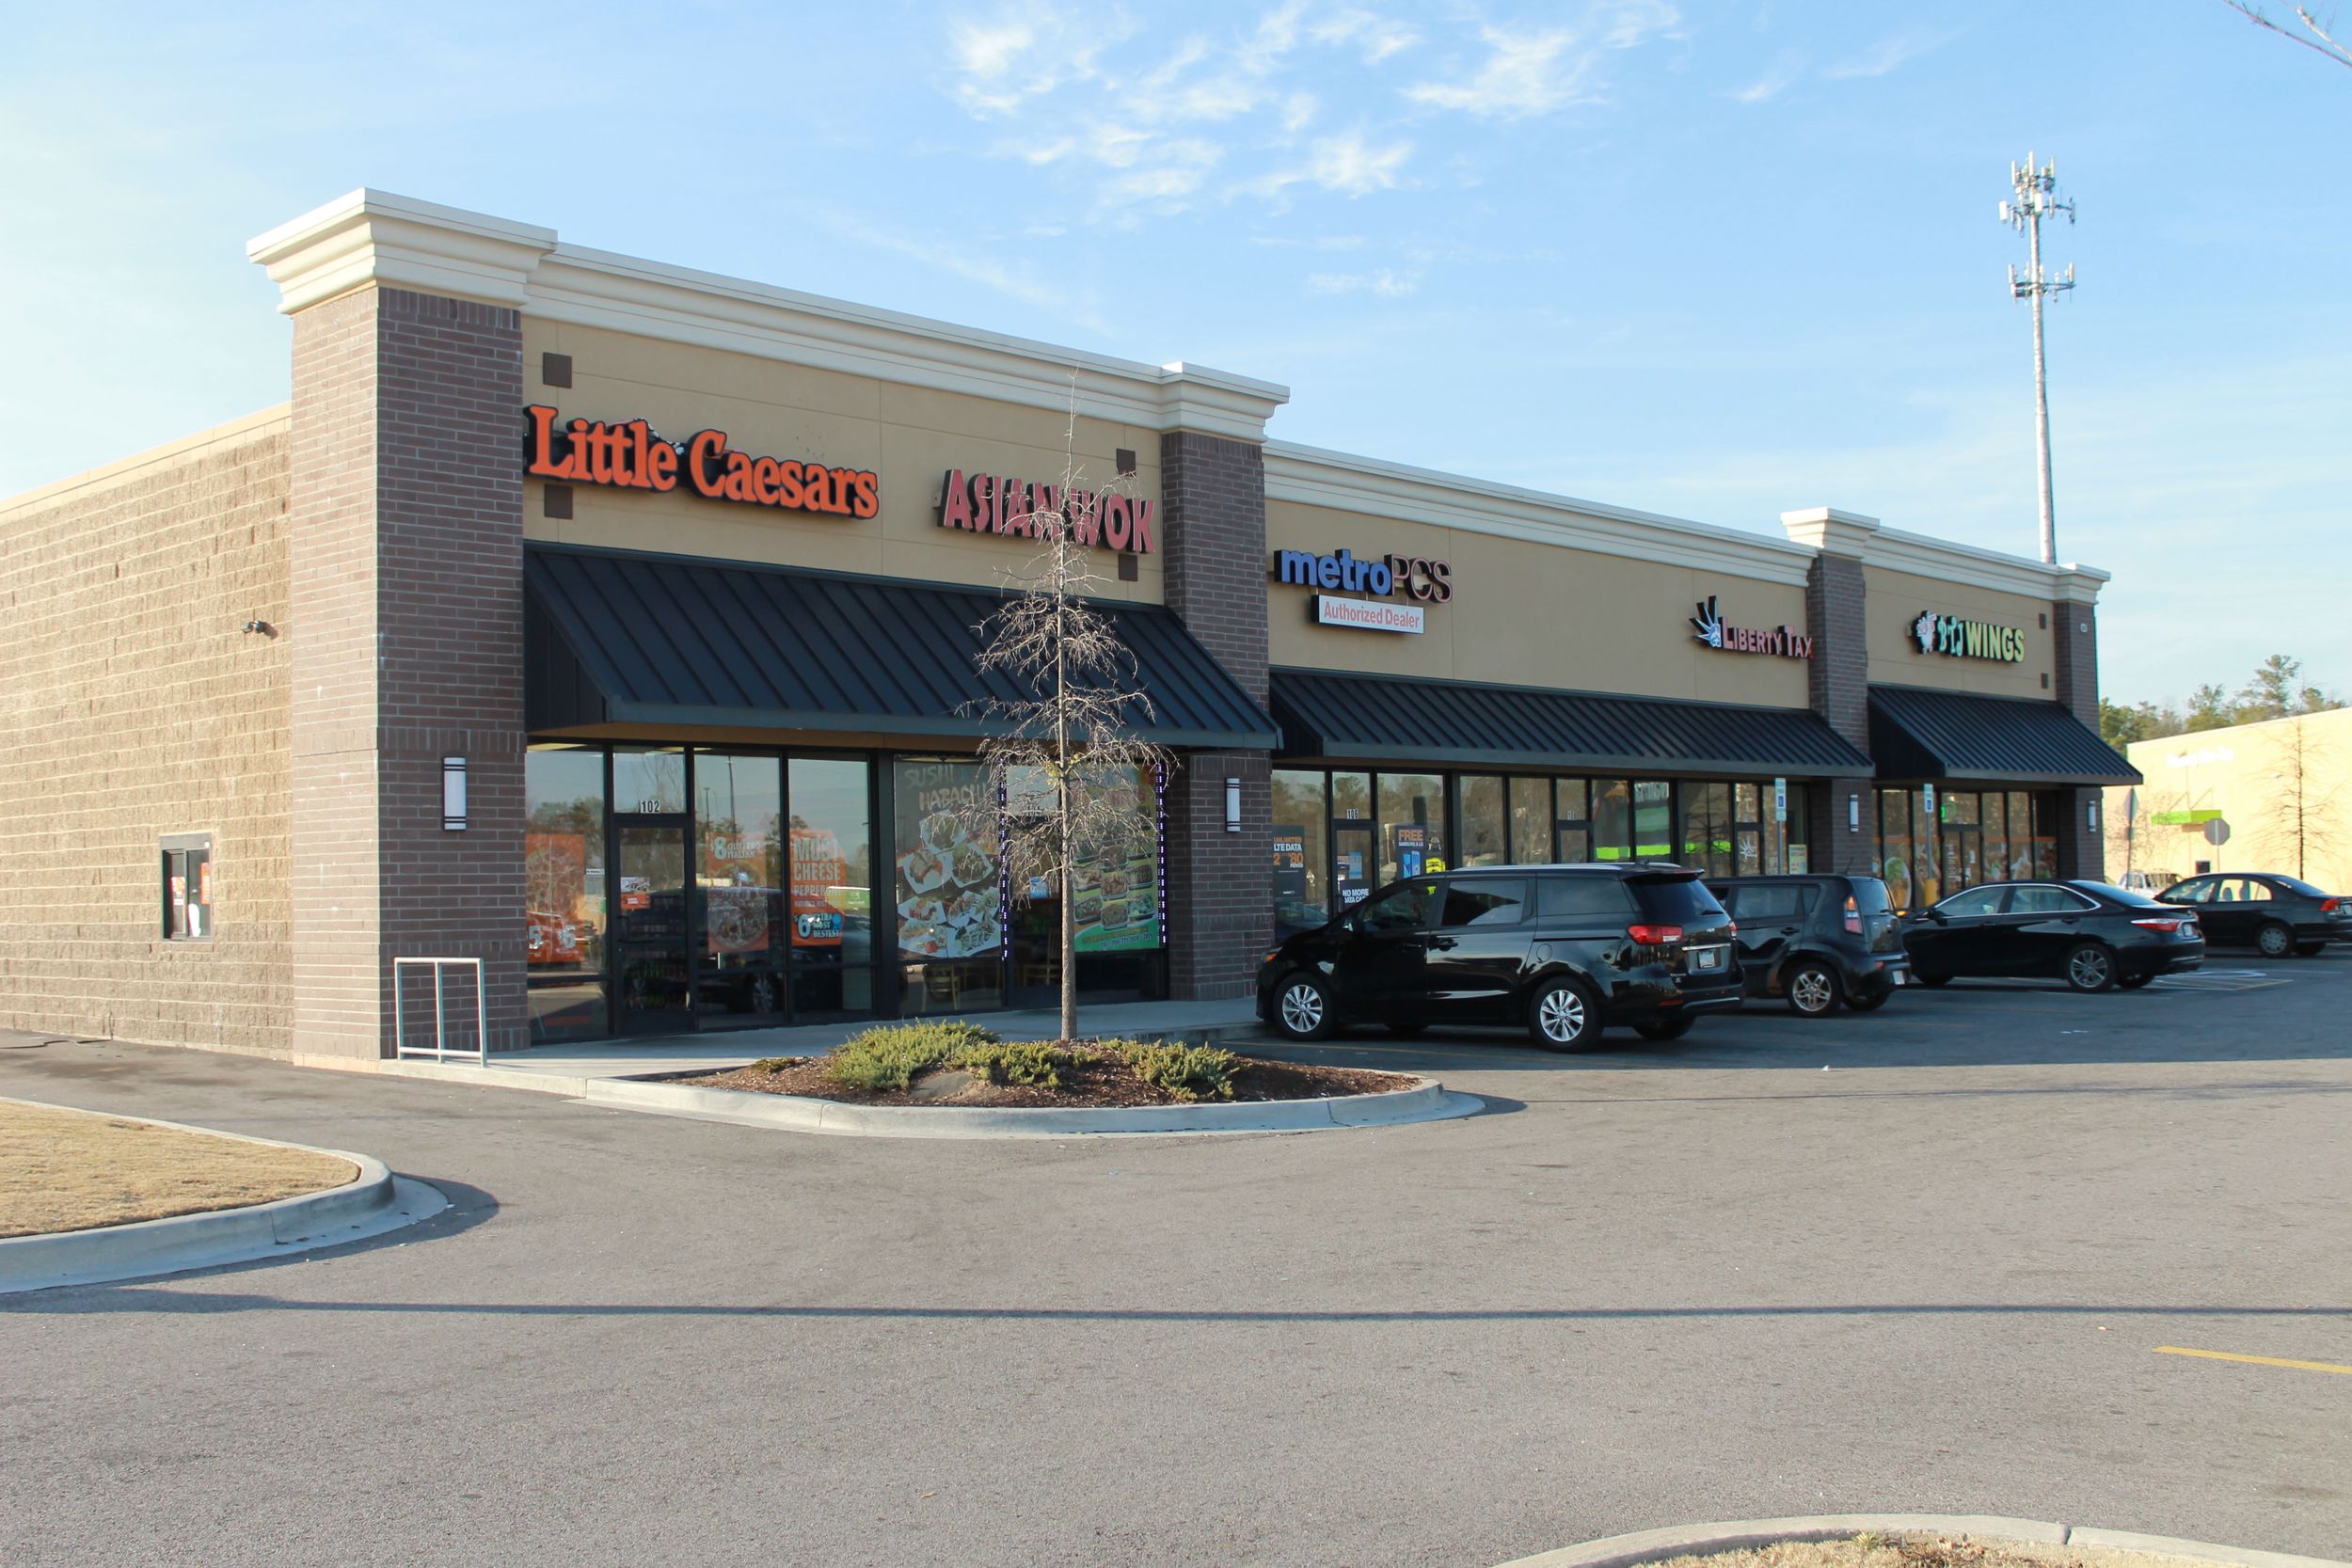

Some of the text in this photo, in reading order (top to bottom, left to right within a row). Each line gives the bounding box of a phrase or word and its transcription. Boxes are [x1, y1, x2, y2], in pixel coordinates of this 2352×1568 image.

[527, 404, 879, 519] Little Caesars
[942, 468, 1155, 554] ASIAN WOK
[1275, 548, 1453, 603] metroPCS
[1324, 601, 1420, 628] Authorized Dealer
[1722, 616, 1813, 658] LIBERTY TAX
[1964, 620, 2025, 663] WINGS
[905, 764, 954, 790] SUSHI
[642, 800, 660, 813] 102
[1273, 843, 1302, 851] LTE DATA
[1398, 830, 1423, 842] FREE
[794, 863, 840, 881] CHEESE
[1352, 888, 1369, 896] MORE
